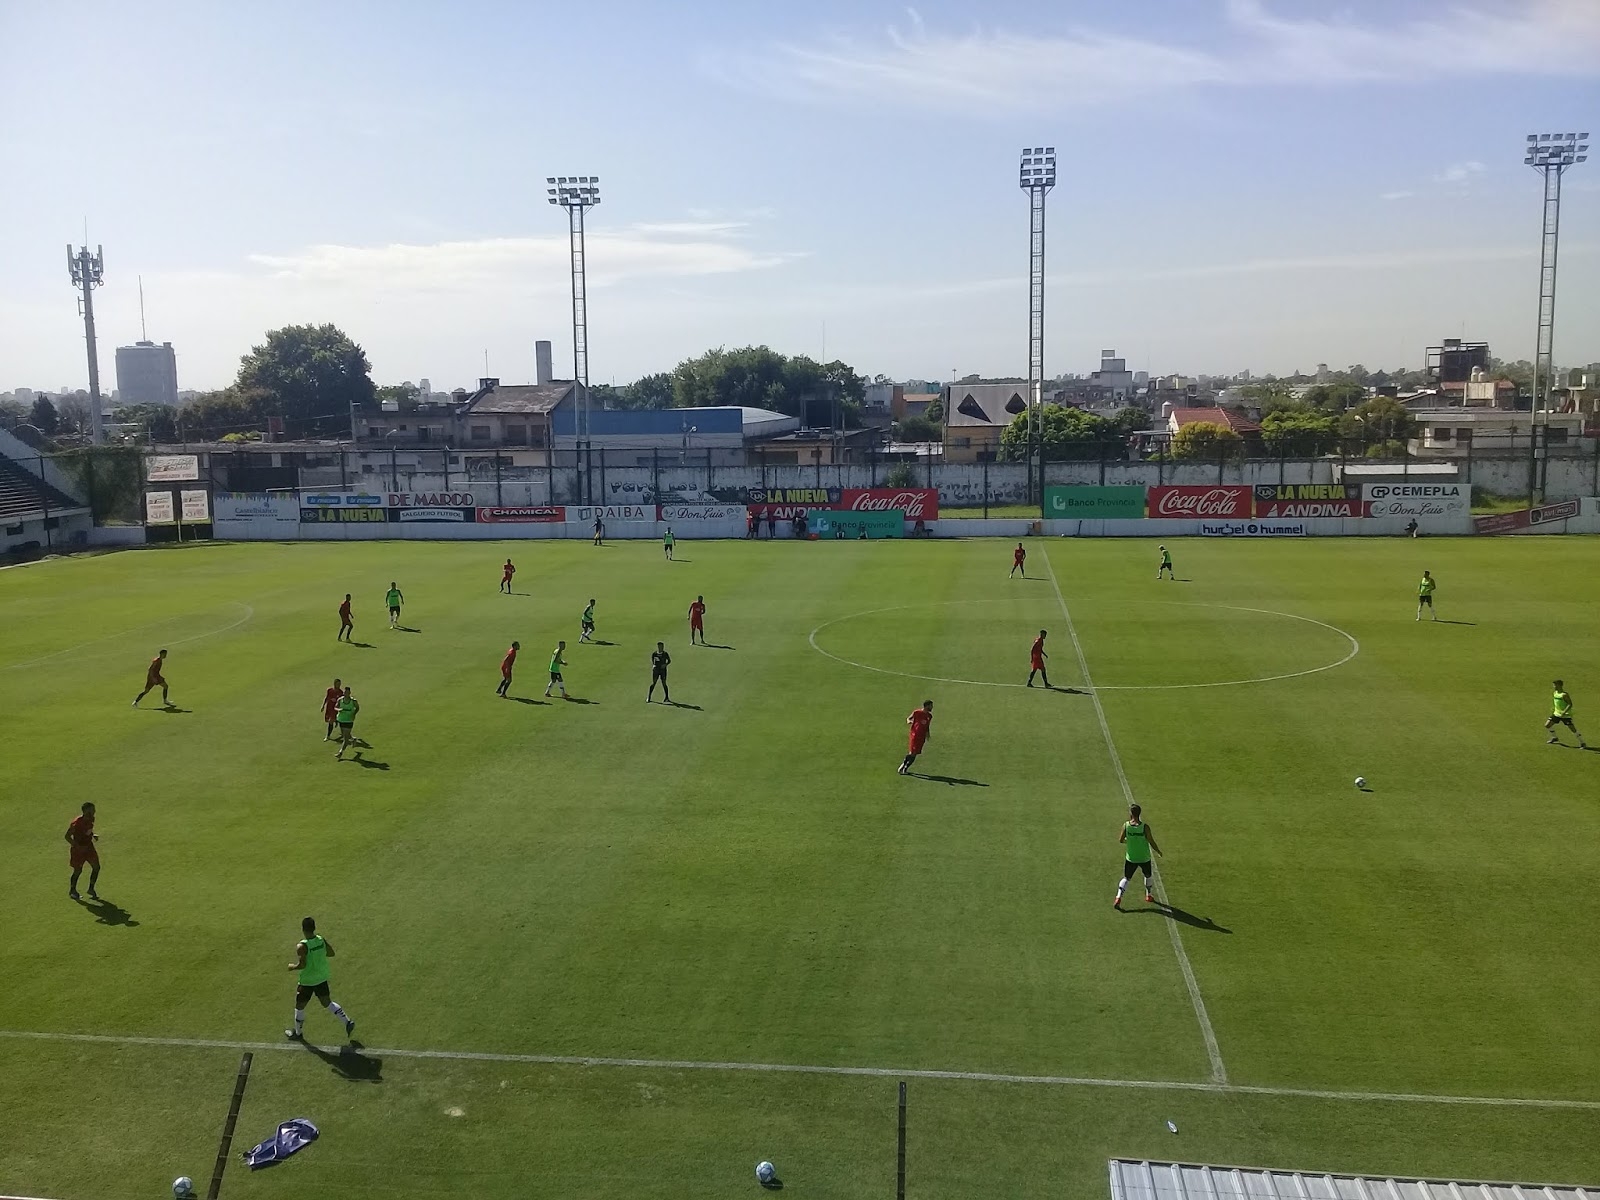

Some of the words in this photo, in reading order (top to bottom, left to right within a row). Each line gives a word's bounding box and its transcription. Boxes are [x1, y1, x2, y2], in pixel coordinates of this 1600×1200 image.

[767, 489, 784, 503] LA
[786, 489, 829, 503] NUEVA
[1277, 486, 1295, 499] LA
[1299, 486, 1345, 499] NUEVA
[1392, 486, 1460, 496] CEMEPLA
[389, 493, 411, 507] DE
[413, 493, 474, 507] MARCO
[1068, 498, 1095, 506] Banco
[1097, 498, 1136, 506] Provincia
[1159, 489, 1241, 515] Coca-Cola
[318, 508, 337, 521] LA
[339, 508, 385, 521] NUEVA
[595, 507, 644, 518] DAIBA
[677, 508, 703, 519] Don
[1282, 504, 1351, 517] ANDINA
[1389, 502, 1417, 515] Don
[1417, 503, 1444, 516] Luis
[860, 521, 896, 529] Provincia
[1260, 524, 1303, 534] hummel
